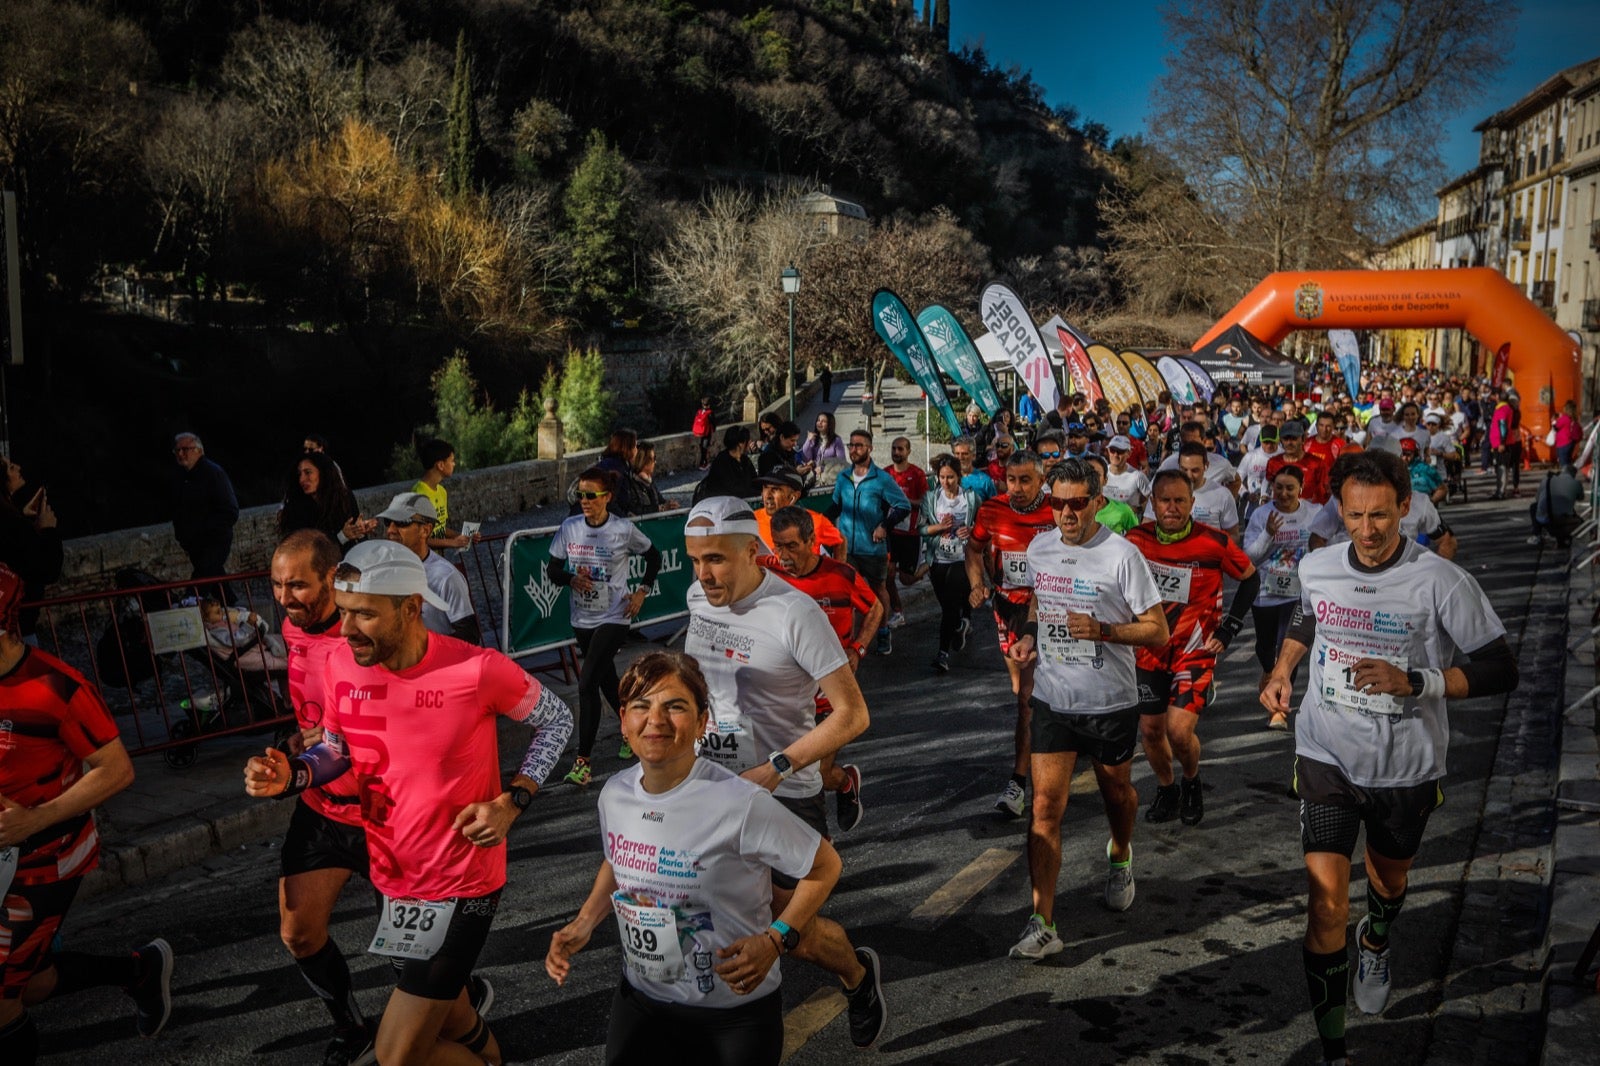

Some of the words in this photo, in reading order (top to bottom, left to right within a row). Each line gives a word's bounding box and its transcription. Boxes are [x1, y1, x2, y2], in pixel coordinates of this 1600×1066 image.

[1329, 293, 1399, 302] AYUNTAMIENTO
[1415, 290, 1461, 300] GRANADA
[1407, 301, 1450, 311] Deportes
[629, 548, 682, 578] RUAL
[1035, 572, 1041, 589] 9
[1042, 573, 1072, 585] Carrera
[1040, 583, 1073, 594] Solidaria
[1317, 600, 1327, 622] 9
[1328, 602, 1371, 619] Carrera
[1047, 624, 1071, 638] 25
[1326, 614, 1373, 632] Solidaria
[1373, 625, 1408, 635] Granada
[716, 636, 751, 653] GRANADA
[1329, 648, 1338, 661] 9
[415, 690, 443, 709] BCC
[616, 834, 657, 857] Carrera
[660, 846, 676, 857] Ave
[614, 849, 657, 874] Solidaria
[657, 866, 697, 878] Granada
[393, 905, 437, 932] 328
[625, 922, 657, 952] 139
